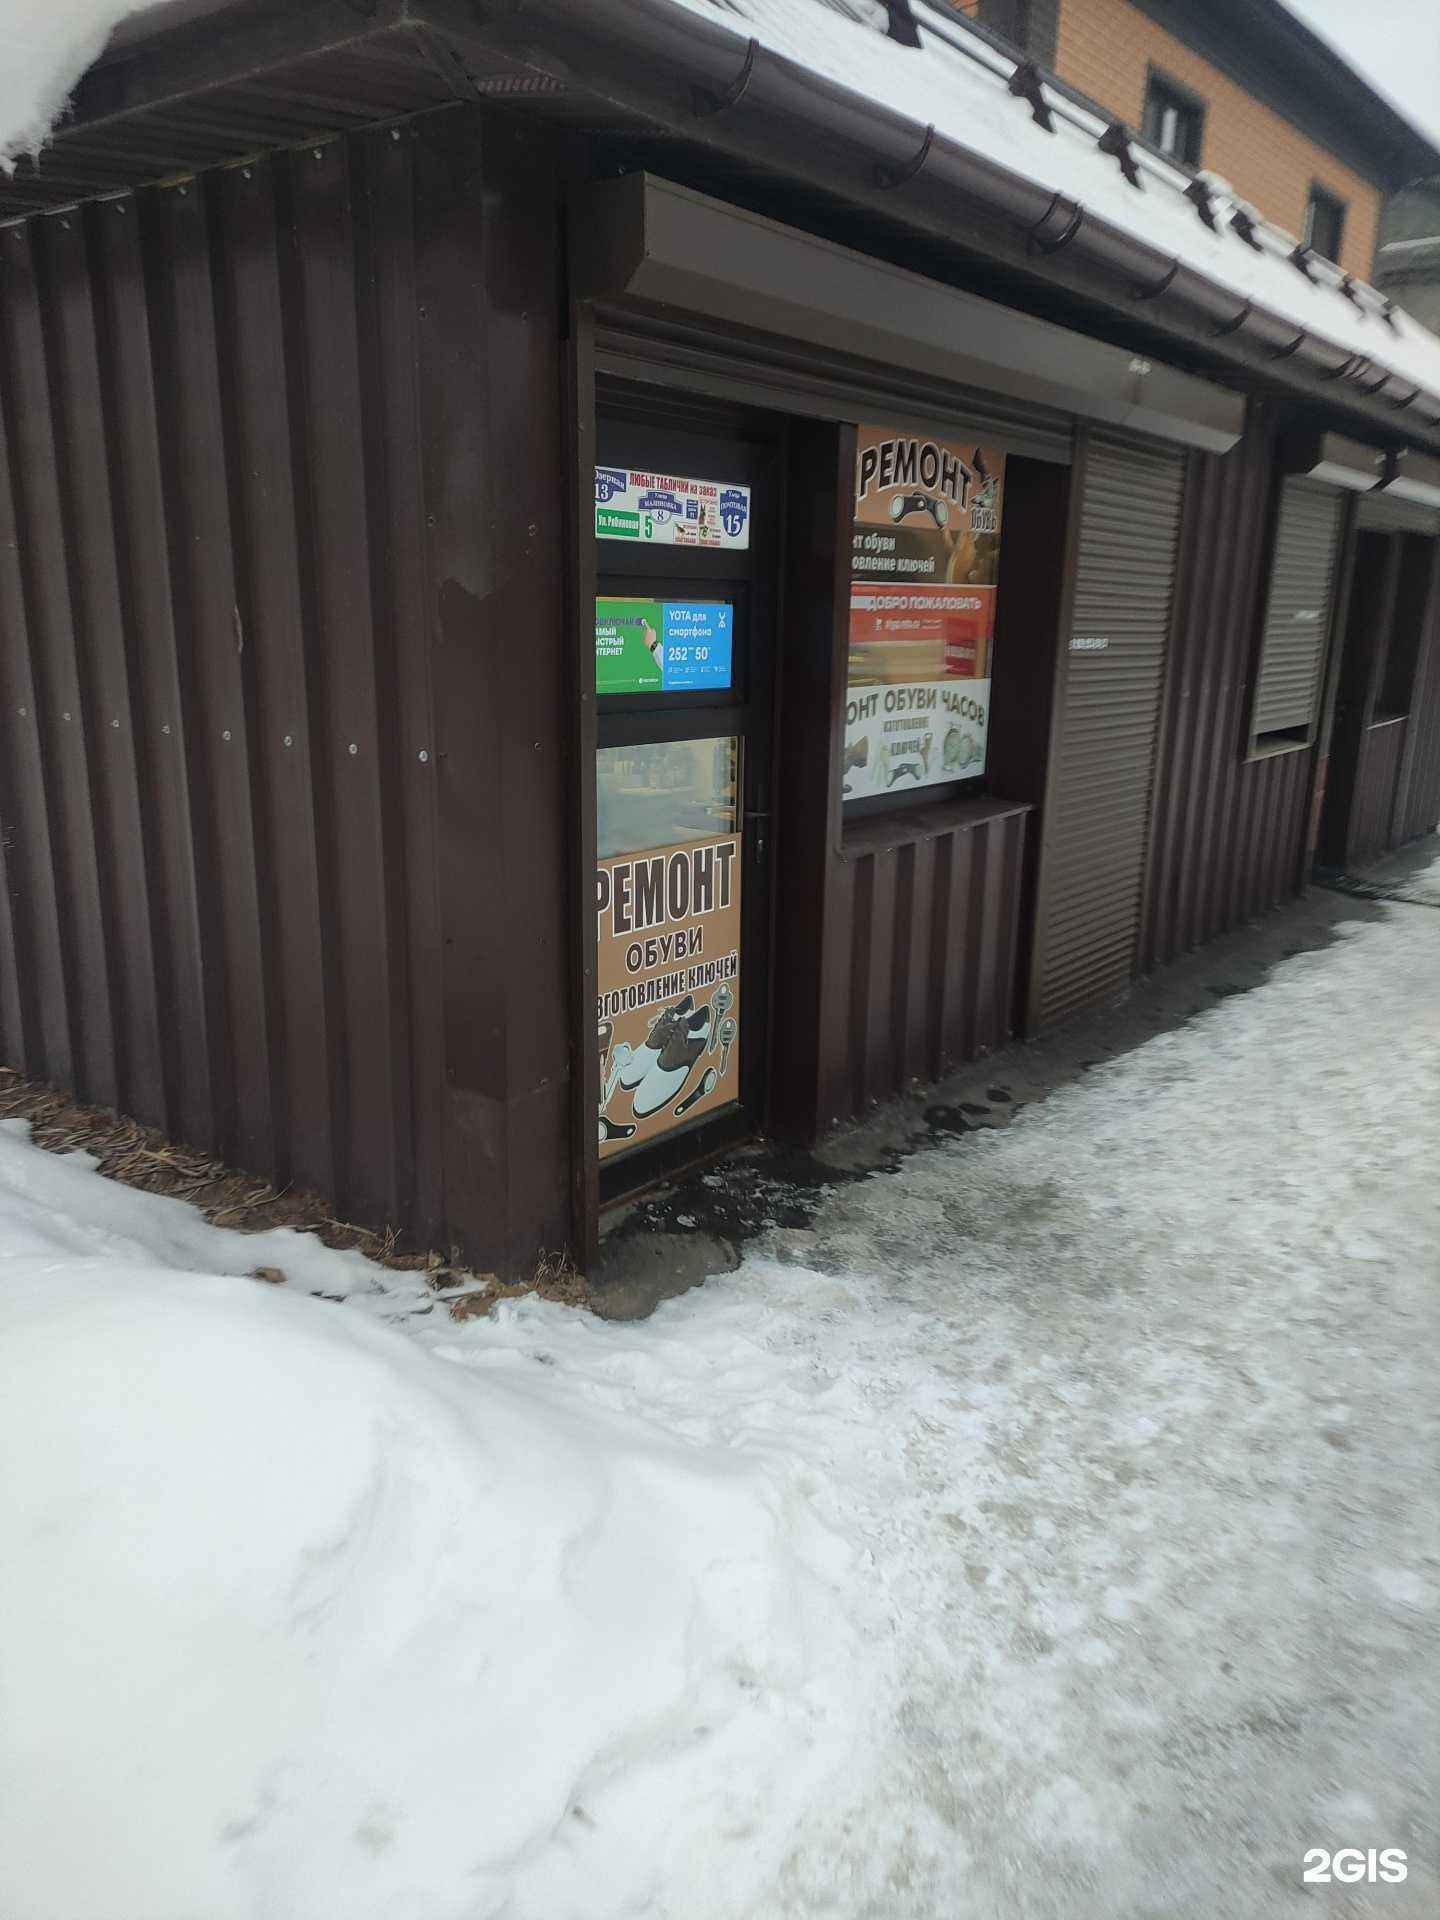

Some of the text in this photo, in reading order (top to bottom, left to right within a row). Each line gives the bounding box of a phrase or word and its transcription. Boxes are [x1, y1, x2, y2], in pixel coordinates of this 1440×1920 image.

[630, 473, 655, 488] ЛЮБЫЕ
[656, 476, 689, 493] ТАБЛИЧКИ
[856, 439, 973, 514] РЕМОНТ
[657, 510, 664, 520] 8
[726, 514, 741, 534] 15
[645, 514, 652, 538] 5
[864, 533, 896, 553] обуви
[866, 596, 909, 612] ДОБРО
[669, 611, 707, 622] YOTA для
[668, 625, 712, 638] смартфона
[668, 647, 708, 661] 252 50
[884, 687, 937, 713] ОБУВИ
[942, 689, 986, 728] ЧАСОВ
[597, 841, 736, 941] РЕМОНТ
[625, 926, 704, 974] ОБУВИ
[686, 951, 738, 991] КЛЮЧЕЙ
